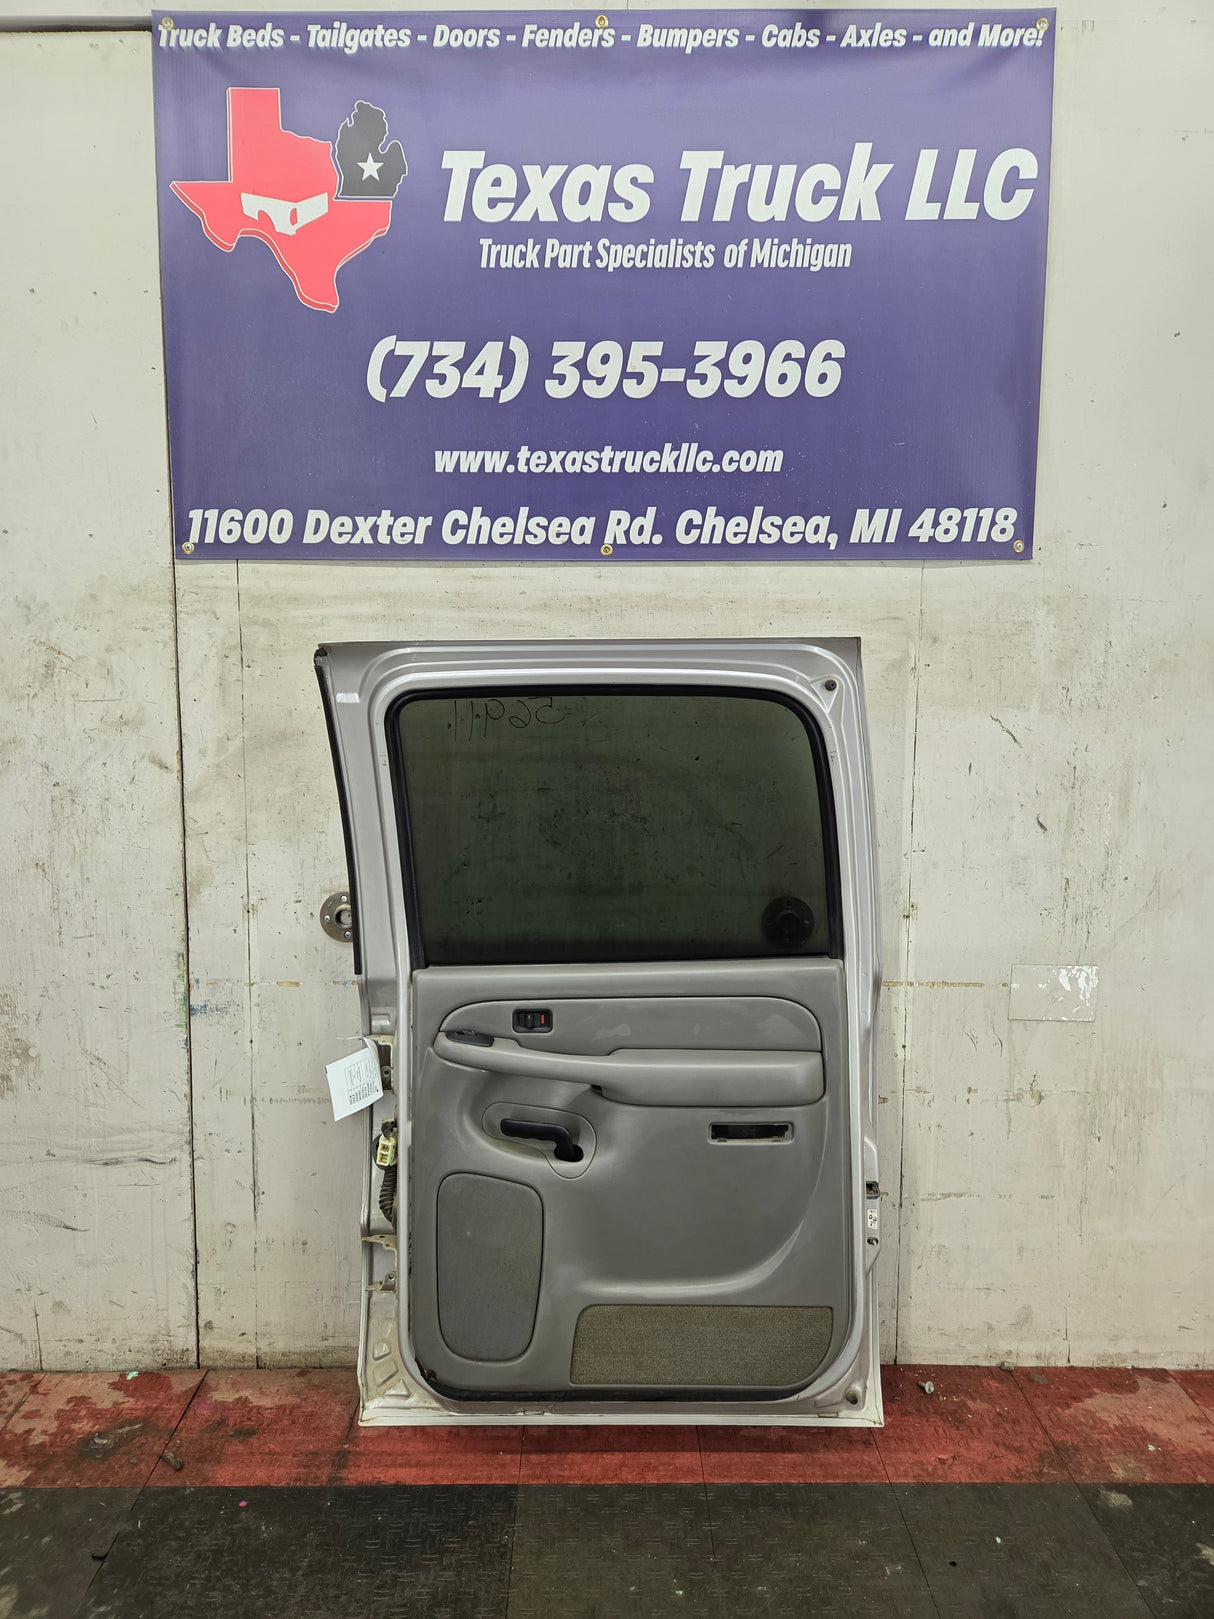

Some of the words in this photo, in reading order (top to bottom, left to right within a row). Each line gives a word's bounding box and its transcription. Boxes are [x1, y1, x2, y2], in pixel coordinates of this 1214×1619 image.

[158, 23, 222, 49] Truck
[226, 23, 285, 49] Beds
[307, 22, 411, 54] Tailgates
[433, 24, 500, 48] Doors
[522, 23, 615, 48] Fenders
[637, 24, 740, 54] Bumpers
[761, 22, 820, 48] Cabs
[840, 22, 907, 48] Axles
[928, 22, 973, 47] and
[977, 24, 1045, 48] More!
[441, 150, 654, 223] Texas
[679, 142, 895, 223] Truck
[904, 148, 1039, 221] LLC
[480, 238, 541, 268] Truck
[544, 238, 592, 268] Part
[595, 238, 715, 272] Specialists
[723, 238, 748, 268] of
[750, 238, 853, 272] Michigan
[366, 335, 530, 403] (734)
[544, 340, 846, 399] 395-3966
[434, 443, 784, 473] www.texastruckllc.com
[187, 509, 293, 544] 11600
[303, 510, 432, 544] Dexter
[441, 507, 596, 545] Chelsea
[604, 507, 663, 544] Rd.
[676, 506, 838, 550] Chelsea,
[850, 508, 902, 543] MI
[908, 508, 1017, 542] 48118
